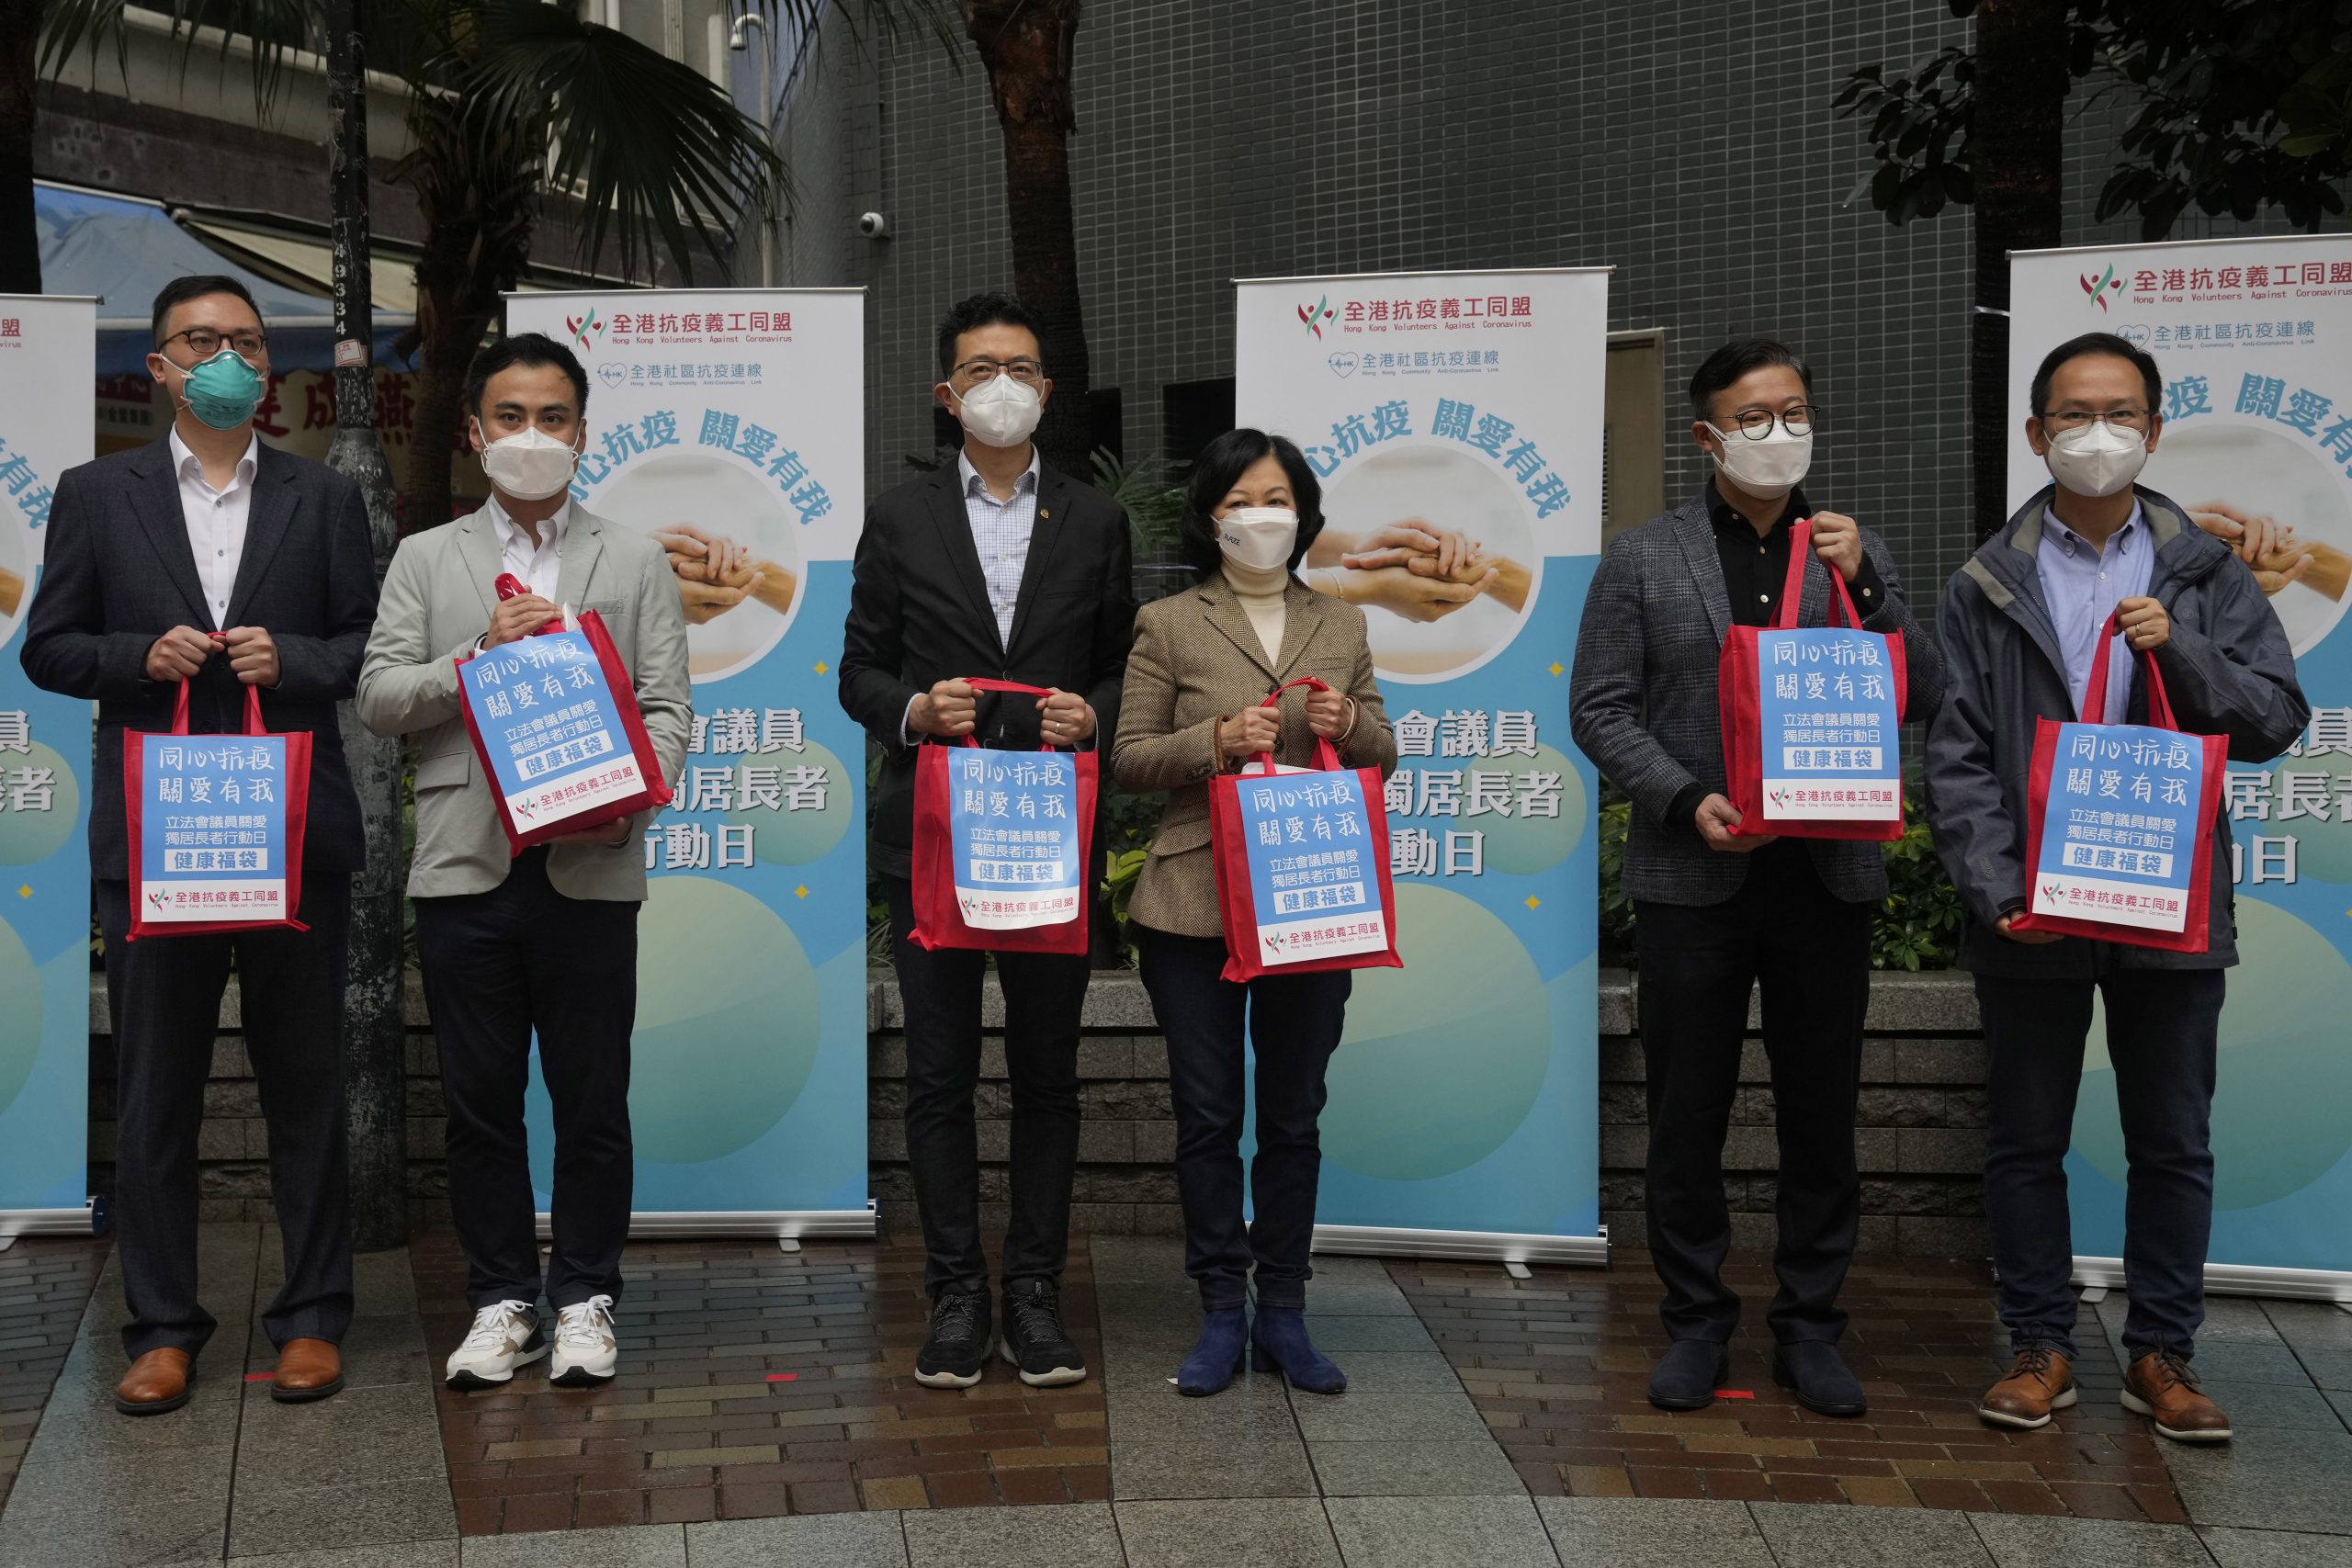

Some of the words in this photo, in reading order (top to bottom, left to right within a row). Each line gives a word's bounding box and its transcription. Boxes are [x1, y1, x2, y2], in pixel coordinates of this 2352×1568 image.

[2133, 262, 2352, 292] 全港抗疫義工同盟
[2133, 294, 2154, 304] Hong
[2162, 293, 2183, 303] Kong
[2191, 291, 2242, 301] Volunteers
[2251, 289, 2287, 300] Against
[2296, 287, 2352, 298] Coronavirus
[1344, 296, 1532, 321] 全港抗疫義工同盟
[612, 311, 792, 333] 全港抗疫義工同盟
[1344, 324, 1363, 333] Hong
[1368, 323, 1386, 333] Kong
[1394, 322, 1437, 332] Volunteers
[1444, 321, 1476, 331] Against
[1483, 320, 1532, 329] Coronavirus
[2154, 320, 2315, 342] 全港社區抗疫連線
[612, 336, 629, 344] Hong
[637, 336, 653, 344] Kong
[661, 335, 702, 344] Volunteers
[709, 335, 739, 344] Against
[745, 334, 792, 343] Coronavirus
[630, 363, 762, 378] 全港社區抗疫連線
[1363, 350, 1499, 367] 全港社區抗疫連線
[698, 408, 832, 525] 關愛有我
[1430, 397, 1571, 520] 關愛有我
[476, 638, 584, 689] 同心抗疫
[1774, 639, 1883, 667] 同心抗疫
[485, 663, 595, 719] 關愛有我
[1775, 671, 1885, 701] 關愛有我
[503, 699, 598, 742] 立法會議員關愛
[1782, 713, 1881, 727] 立法會議員關愛
[510, 715, 603, 758] 獨居長者行動日
[1782, 729, 1881, 743] 獨居長者行動日
[159, 746, 275, 771] 同心抗疫
[526, 736, 604, 776] 健康福袋
[1792, 750, 1872, 768] 健康福袋
[2072, 735, 2191, 771] 同心抗疫
[964, 759, 1067, 786] 同心抗疫
[159, 776, 275, 804] 關愛有我
[540, 766, 634, 806] 全港抗疫義工同盟
[1253, 780, 1355, 813] 同心抗疫
[1795, 790, 1893, 802] 全港抗疫義工同盟
[2066, 768, 2188, 807] 關愛有我
[964, 790, 1067, 819] 關愛有我
[164, 815, 267, 829] 立法會議員關愛
[1258, 811, 1361, 846] 關愛有我
[2069, 808, 2177, 833] 立法會議員關愛
[164, 831, 266, 845] 獨居長者行動日
[970, 828, 1061, 843] 立法會議員關愛
[2067, 825, 2174, 850] 獨居長者行動日
[175, 851, 257, 870] 健康福袋
[970, 843, 1061, 859] 獨居長者行動日
[1270, 849, 1359, 872] 立法會議員關愛
[2073, 846, 2162, 874] 健康福袋
[978, 862, 1054, 881] 健康福袋
[1272, 865, 1360, 888] 獨居長者行動日
[175, 890, 278, 903] 全港抗疫義工同盟
[1283, 886, 1357, 911] 健康福袋
[2069, 887, 2178, 912] 全港抗疫義工同盟
[1289, 922, 1379, 944] 全港抗疫義工同盟
